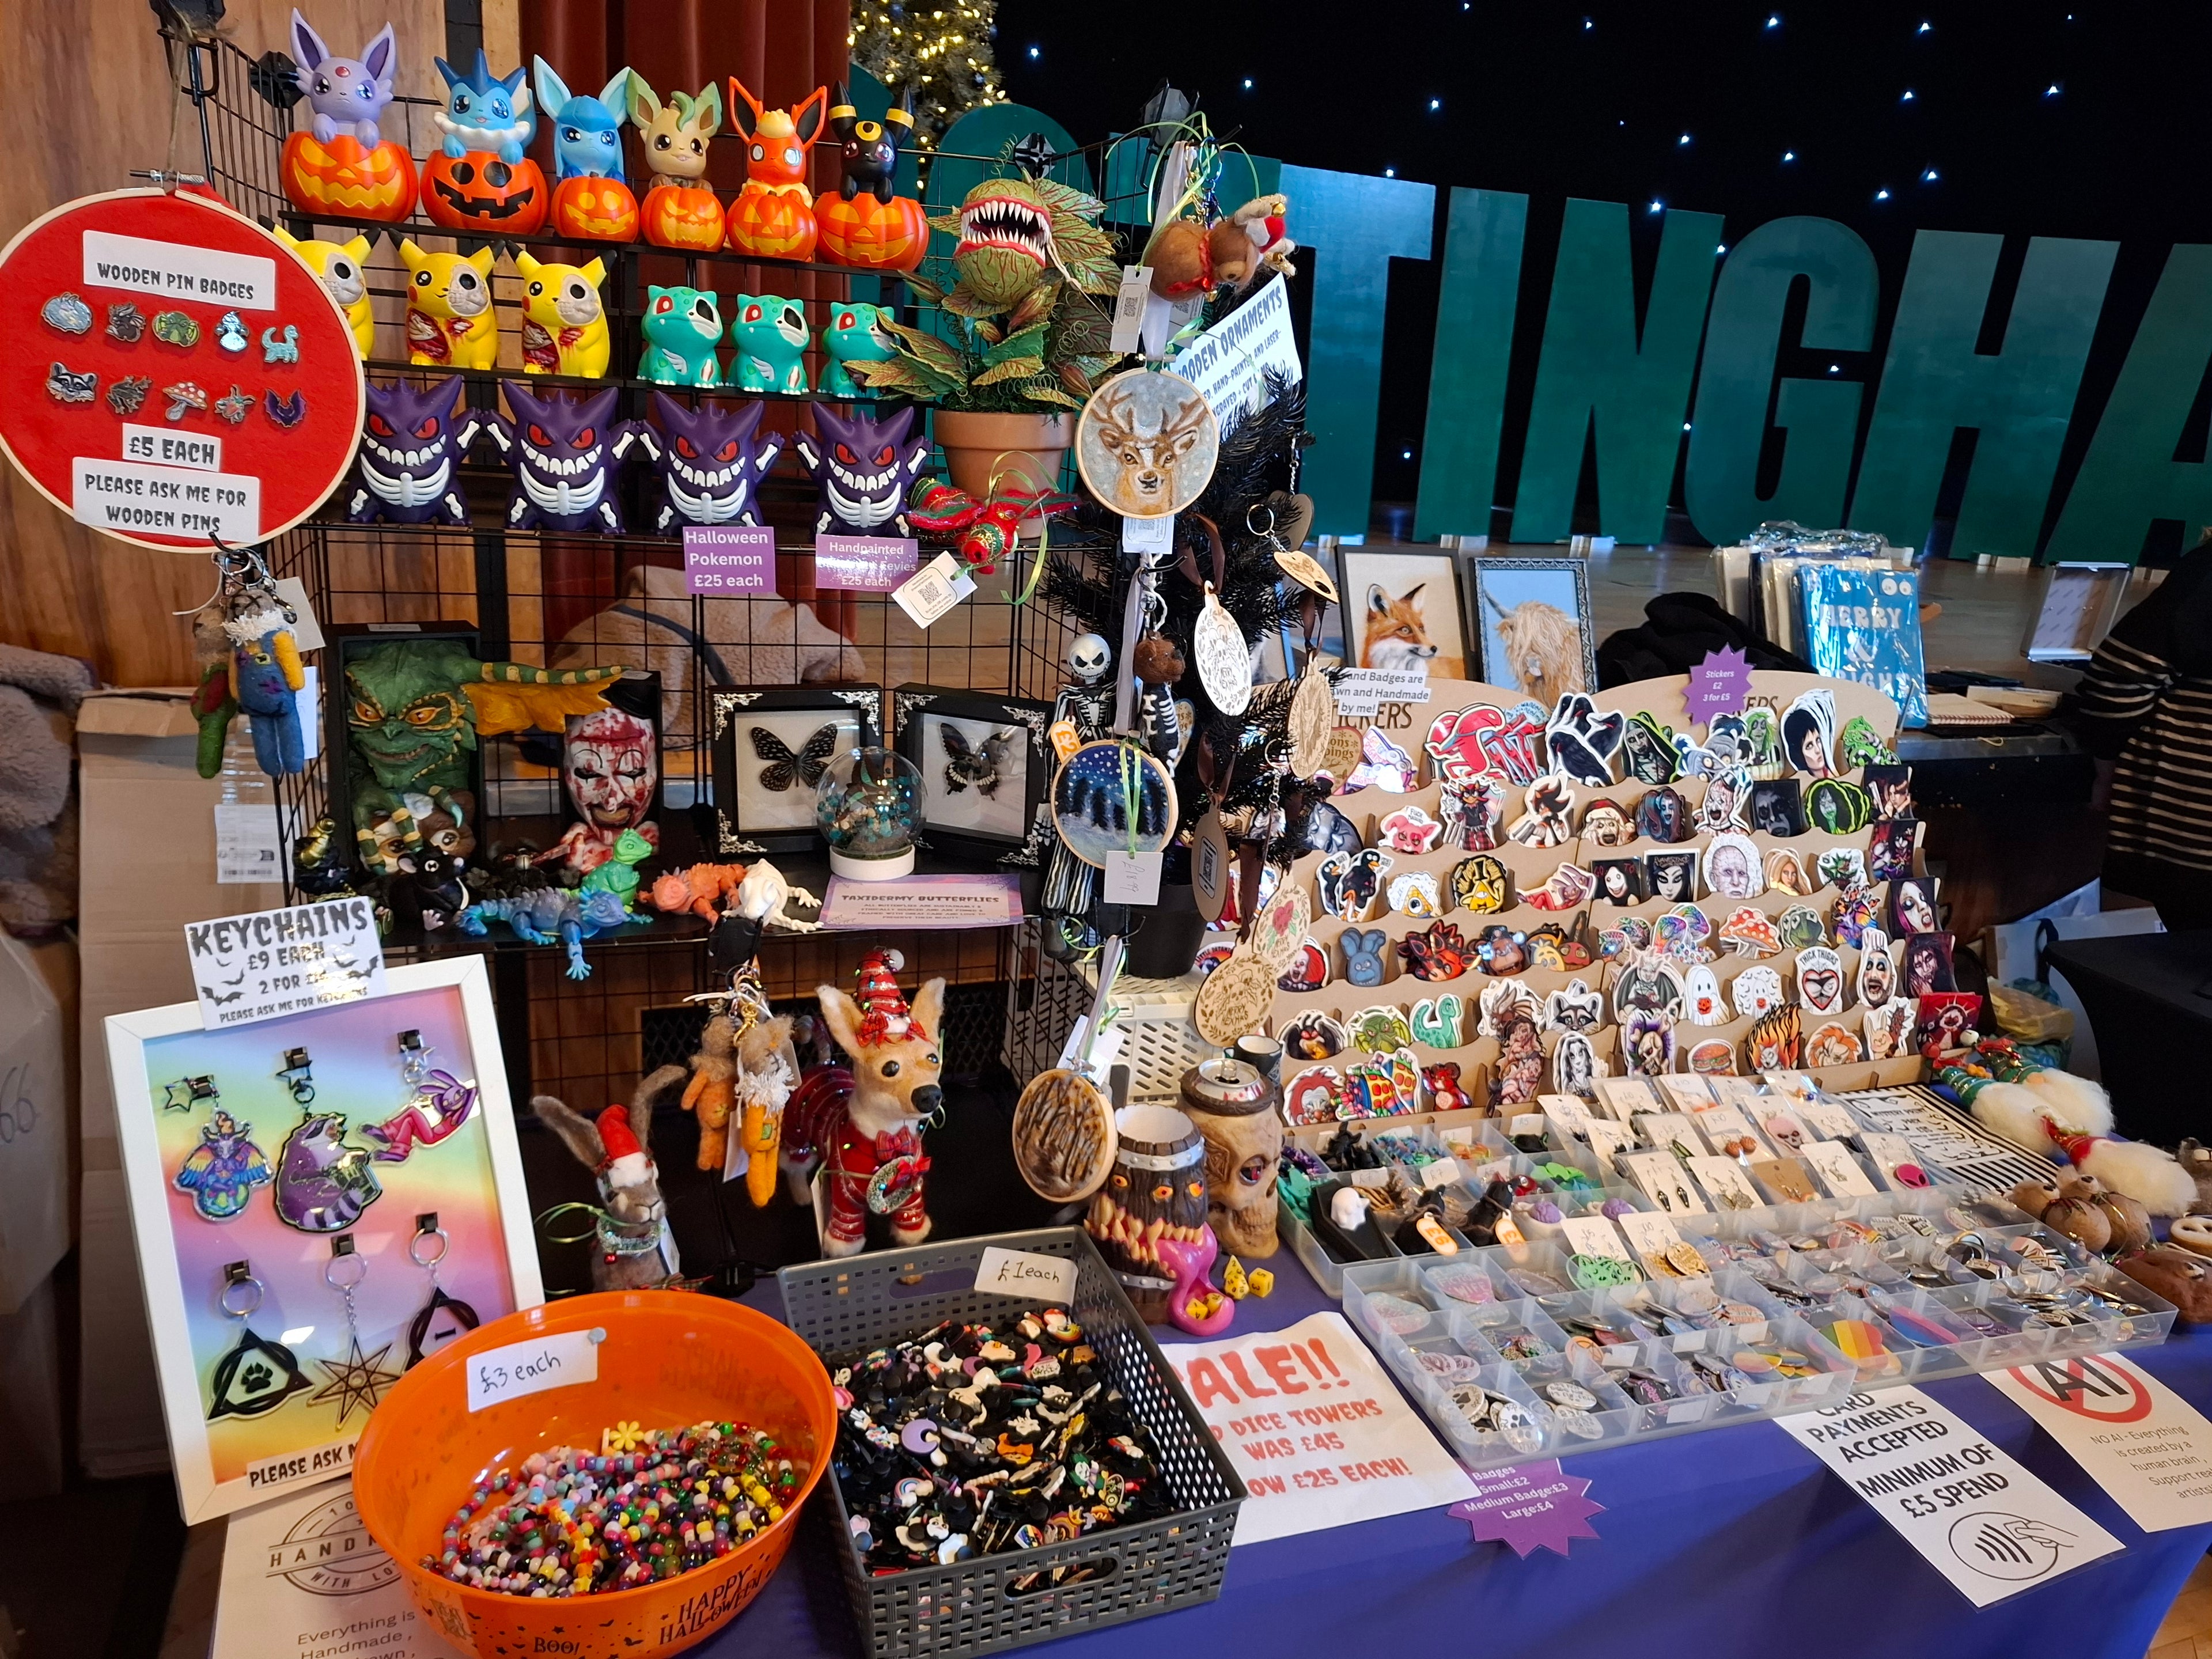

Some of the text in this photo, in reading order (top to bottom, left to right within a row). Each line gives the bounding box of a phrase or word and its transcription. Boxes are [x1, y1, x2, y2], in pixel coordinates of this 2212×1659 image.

[97, 263, 254, 300] WOODEN PIN BADGES
[1176, 339, 1218, 384] OODEN
[1220, 285, 1283, 357] ORNAMENTS
[128, 436, 215, 465] £5 EACH
[85, 473, 246, 507] PLEASE ASK ME FOR
[105, 505, 220, 532] WOODEN PINS
[685, 530, 768, 544] Halloween
[830, 541, 904, 555] Handpainted
[690, 553, 763, 566] Pokemon
[694, 574, 763, 588] £25 each
[841, 576, 892, 587] £25 each
[1369, 672, 1406, 684] Badges
[1408, 675, 1423, 684] are
[1705, 670, 1734, 679] Stickers
[1712, 681, 1723, 690] £2
[1353, 687, 1372, 697] and
[1375, 688, 1429, 700] Handmade
[1702, 692, 1730, 702] 3 for £5
[1341, 703, 1376, 714] by me!
[1055, 729, 1078, 757] £2
[188, 900, 369, 957] KEYCHAINS
[247, 950, 270, 970] £9
[259, 980, 269, 995] 2
[272, 974, 300, 992] FOR
[219, 1007, 254, 1024] PLEASE
[257, 1003, 275, 1017] ASK
[278, 1000, 293, 1012] ME
[296, 995, 314, 1008] FOR
[480, 1350, 561, 1393] £3 each
[1179, 1337, 1350, 1409] ALE!!
[2031, 1355, 2130, 1402] AI
[1229, 1413, 1287, 1438] DICE
[1291, 1398, 1383, 1427] TOWERS
[1806, 1400, 1927, 1443] PAYMENTS
[1241, 1431, 1345, 1461] WAS £45
[1838, 1420, 1948, 1463] ACCEPTED
[2090, 1435, 2111, 1445] NO
[2111, 1433, 2125, 1442] AI
[2128, 1425, 2190, 1440] Everything
[2113, 1448, 2128, 1458] is
[2127, 1442, 2168, 1457] created
[2167, 1441, 2185, 1452] by
[249, 1441, 359, 1488] PLEASE ASK M
[1472, 1466, 1516, 1481] Badges
[1855, 1443, 1995, 1498] MINIMUM OF
[2130, 1455, 2200, 1472] human brain
[1247, 1457, 1412, 1498] OW £25 EACH!
[2149, 1472, 2198, 1486] Support
[1464, 1495, 1515, 1513] Medium
[1900, 1472, 2009, 1519] £5 SPEND
[270, 1532, 379, 1568] HANDM
[310, 1562, 396, 1589] WITH LO
[677, 1563, 753, 1624] HAPPY
[659, 1571, 762, 1646] HALLOWEEN
[298, 1611, 415, 1646] Everything is
[301, 1632, 402, 1659] Handmade
[533, 1637, 581, 1656] BOO!
